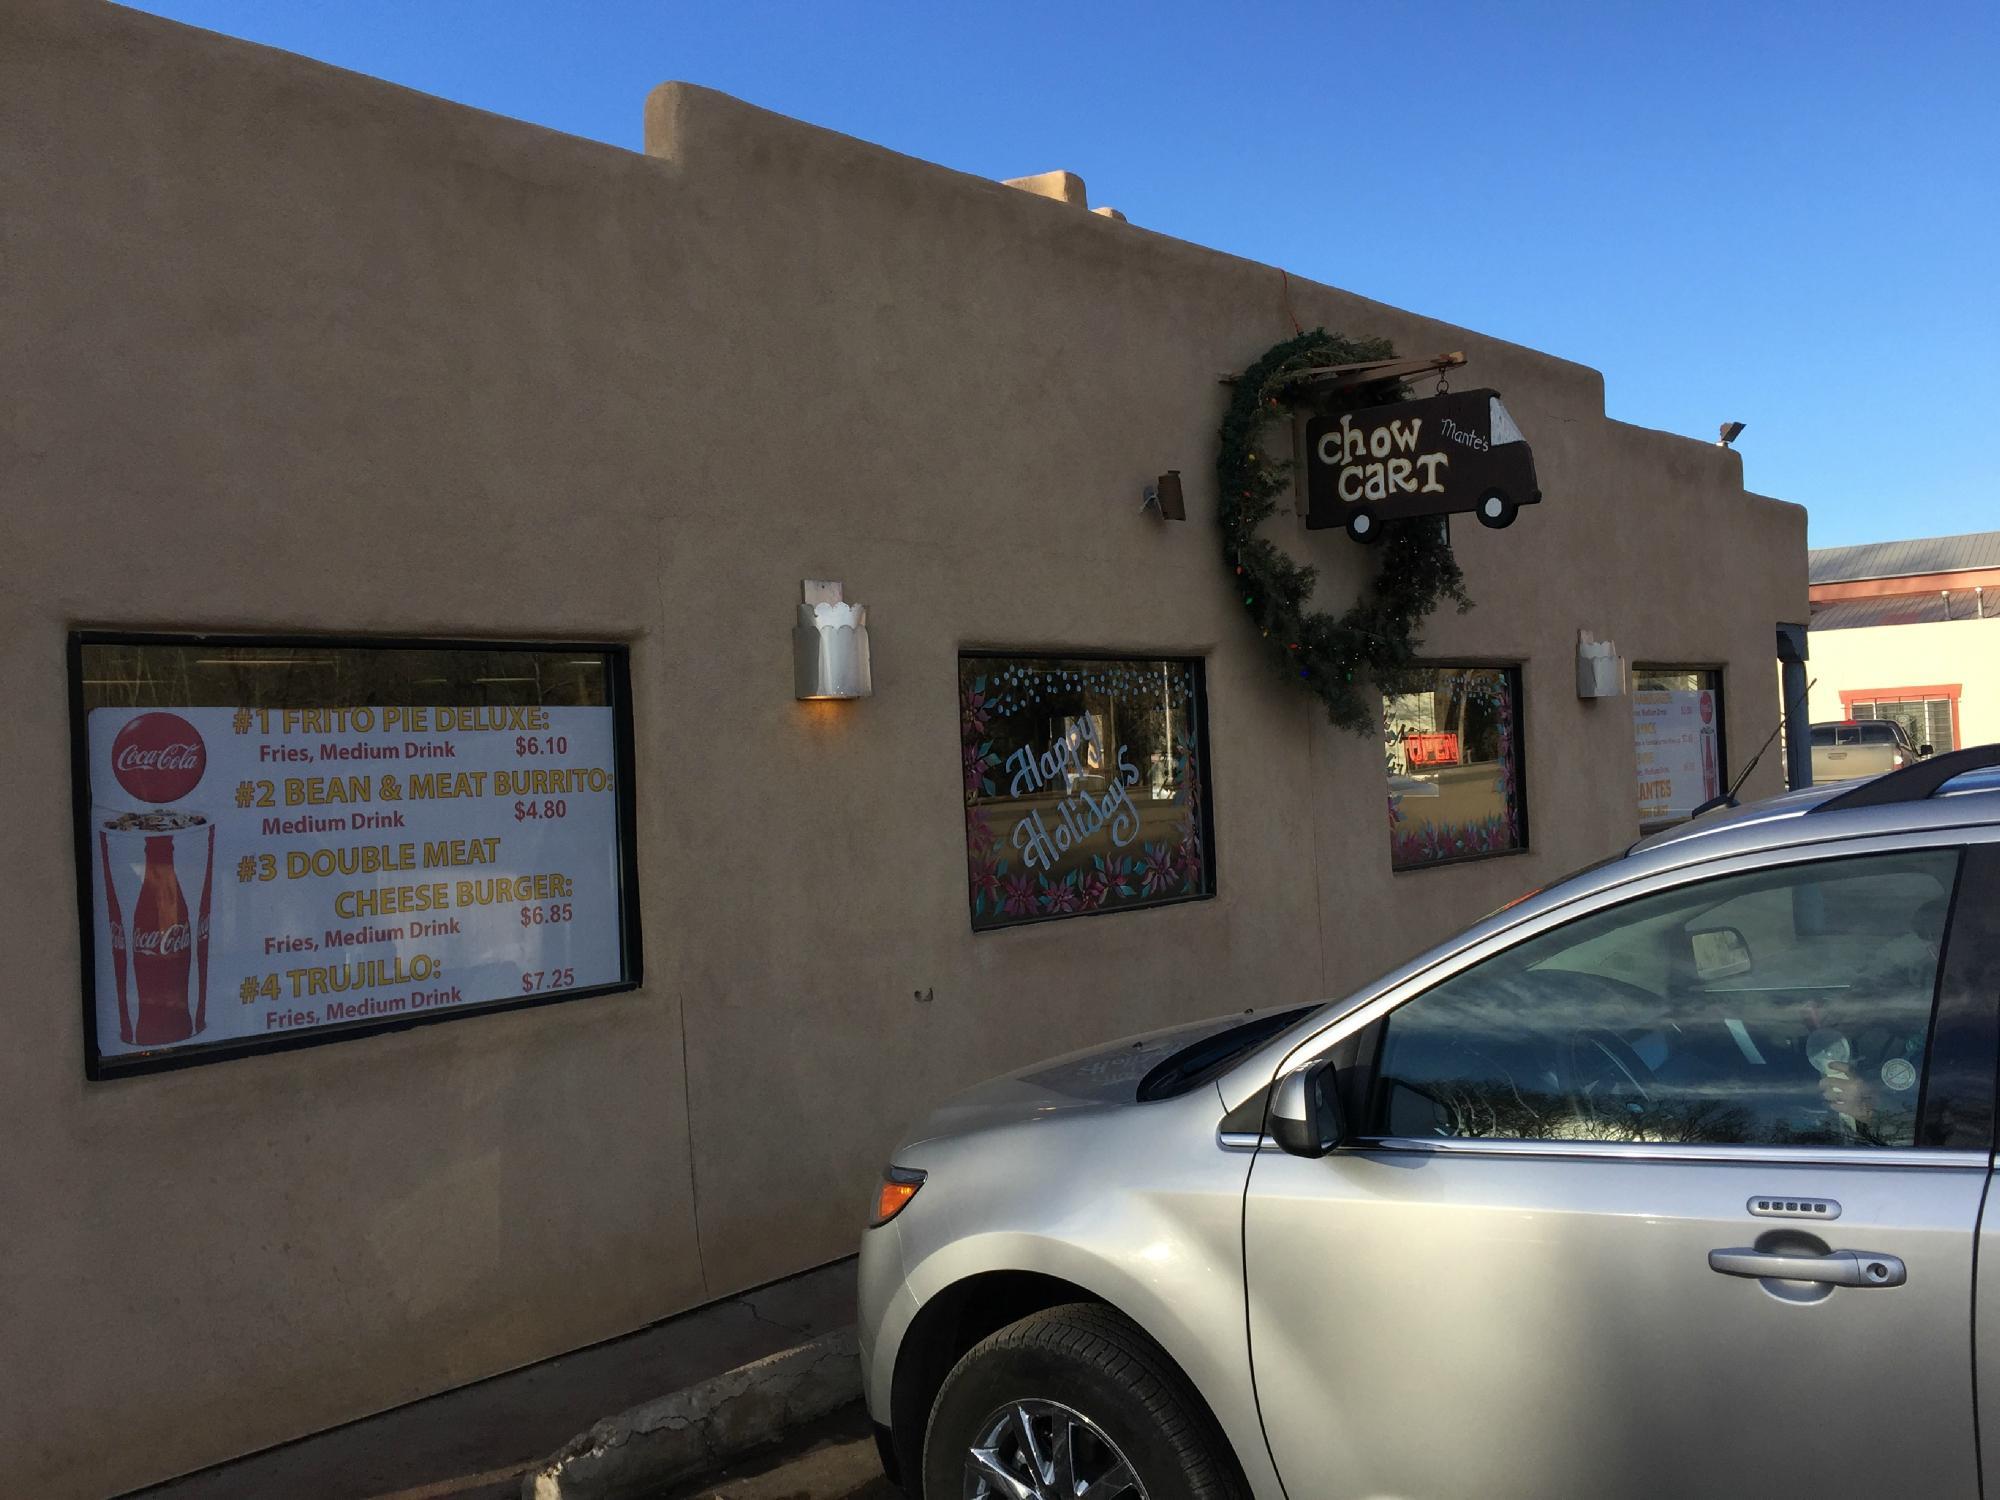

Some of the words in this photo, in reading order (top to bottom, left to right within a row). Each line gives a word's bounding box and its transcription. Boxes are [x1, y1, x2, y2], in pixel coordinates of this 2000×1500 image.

[1441, 418, 1489, 452] Mante's
[232, 706, 270, 735] #1
[282, 706, 376, 734] FRITO
[382, 706, 429, 733] PIE
[434, 706, 550, 732] DELUXE:
[116, 743, 200, 772] Coca-Cola
[259, 743, 314, 763] Fries,
[319, 741, 400, 761] Medium
[404, 740, 456, 759] Drink
[515, 735, 568, 758] $6.10
[1005, 709, 1102, 798] Happy
[234, 779, 276, 808] #2
[284, 775, 371, 806] BEAN
[379, 774, 402, 801] &
[409, 771, 487, 799] MEAT
[494, 767, 614, 796] BURRITO:
[1013, 744, 1140, 871] Holidays
[262, 814, 346, 836] Medium
[351, 810, 405, 831] Drink
[514, 799, 567, 823] $4.80
[236, 853, 278, 883] #3
[287, 842, 416, 880] DOUBLE
[423, 837, 501, 869] MEAT
[335, 882, 449, 919] CHEESE
[456, 873, 573, 907] BURGER:
[264, 935, 319, 955] Fries,
[325, 926, 404, 948] Medium
[409, 917, 461, 939] Drink
[520, 903, 573, 928] $6.85
[239, 973, 282, 1005] #4
[286, 953, 441, 999] TRUJILLO:
[266, 1009, 321, 1030] Fries,
[326, 996, 406, 1021] Medium
[411, 986, 462, 1009] Drink
[521, 967, 575, 994] $7.25
